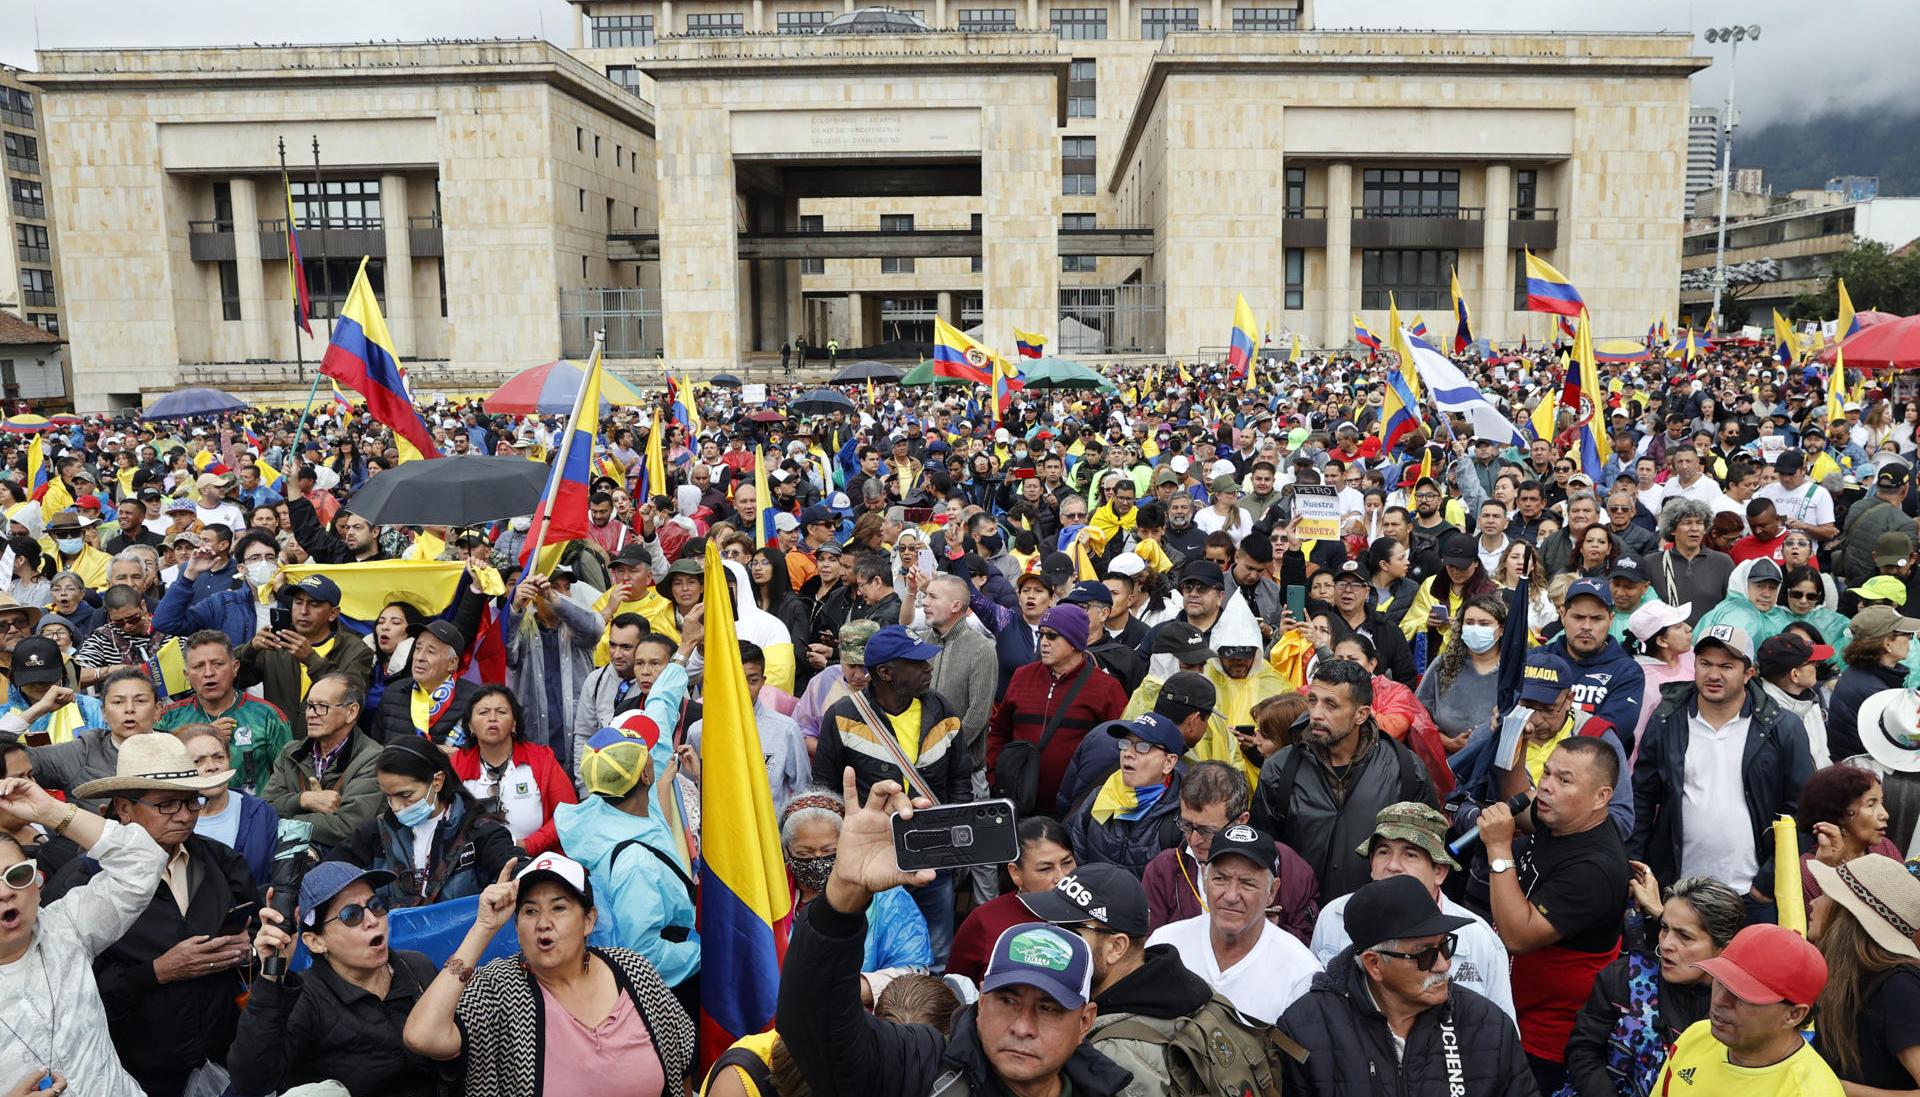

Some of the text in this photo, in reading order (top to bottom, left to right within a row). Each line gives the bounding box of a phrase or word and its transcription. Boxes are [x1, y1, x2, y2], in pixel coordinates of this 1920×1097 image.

[1297, 486, 1332, 495] PETRO
[1303, 499, 1334, 508] Nuestra
[1298, 527, 1336, 536] RESPETA
[149, 661, 163, 688] OMBIA
[1056, 875, 1092, 906] das
